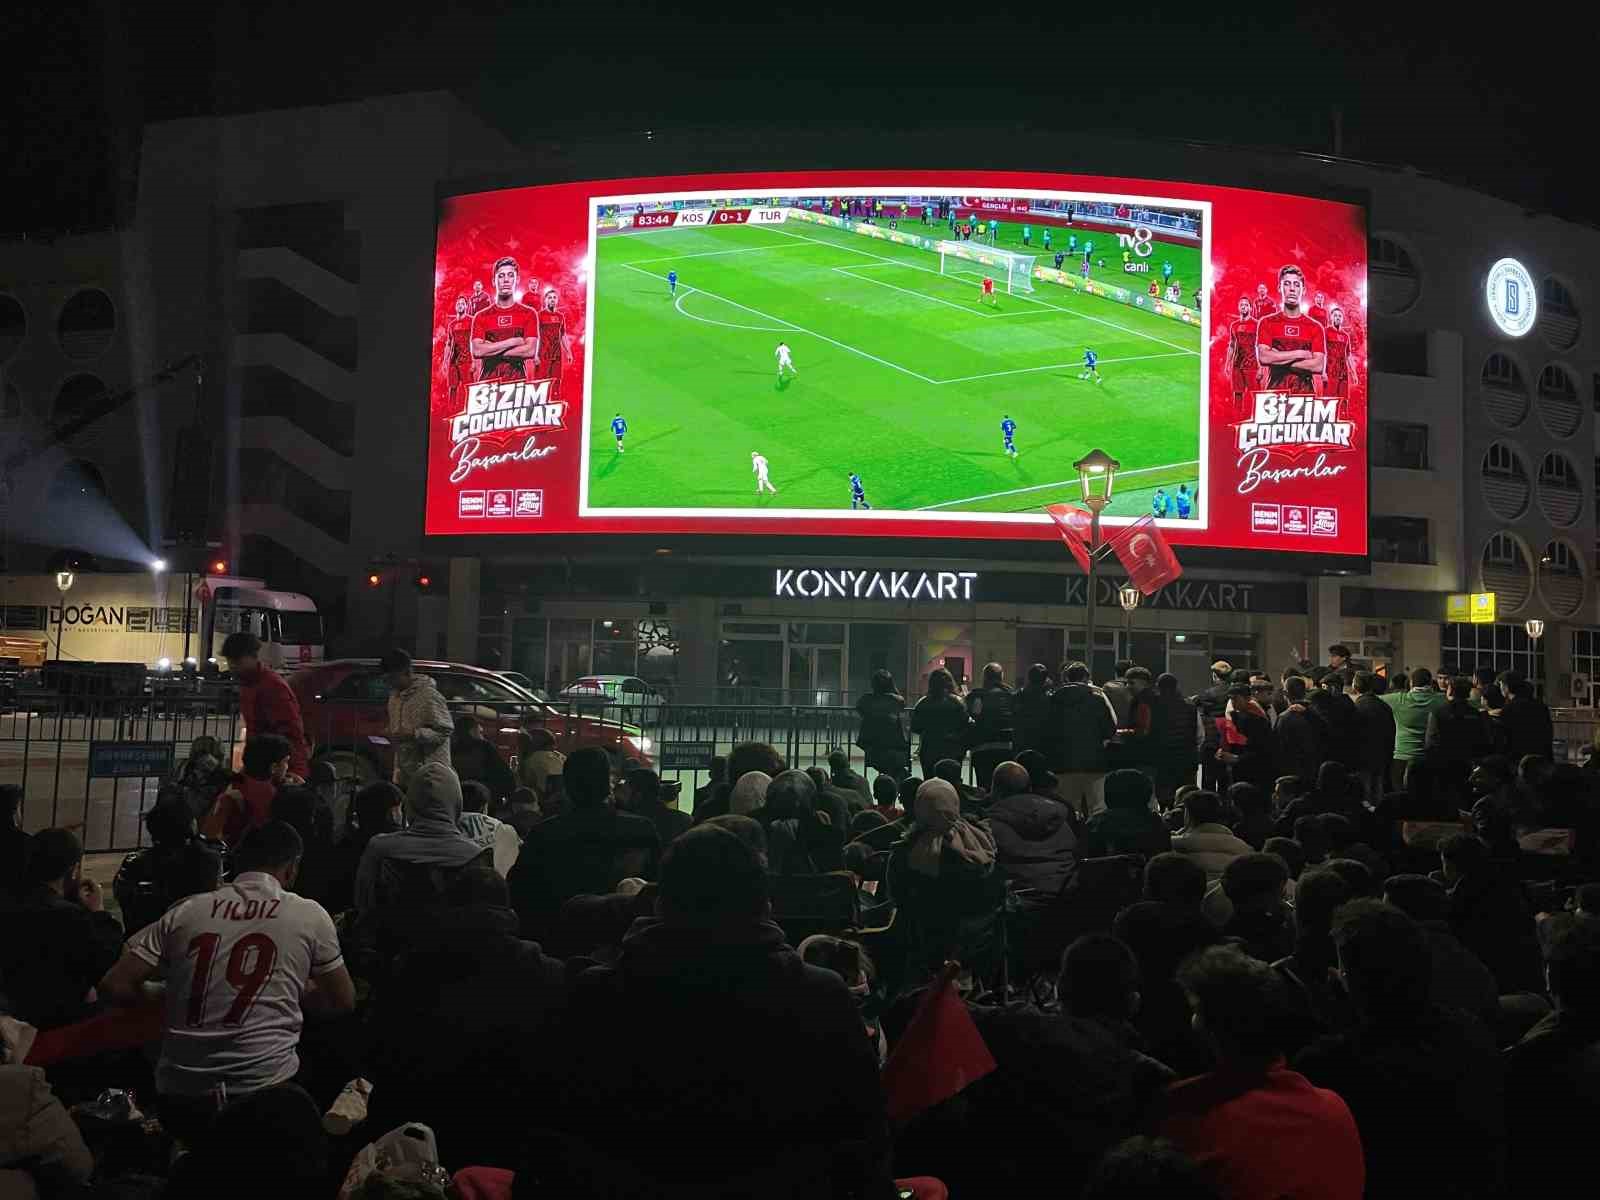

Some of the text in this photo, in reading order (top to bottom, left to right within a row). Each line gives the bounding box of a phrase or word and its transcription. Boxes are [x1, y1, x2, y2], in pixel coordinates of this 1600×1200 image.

[639, 215, 669, 224] 83:44
[681, 210, 704, 222] KOS
[759, 211, 781, 220] TUR
[451, 404, 562, 443] ÇOCUKLAR
[1239, 422, 1351, 453] ÇOCUKLAR
[449, 436, 557, 482] Başarılar
[1237, 448, 1347, 494] Başarılar
[775, 568, 977, 600] KONYAKART
[50, 603, 123, 624] DOĞAN
[185, 931, 278, 1028] 19
